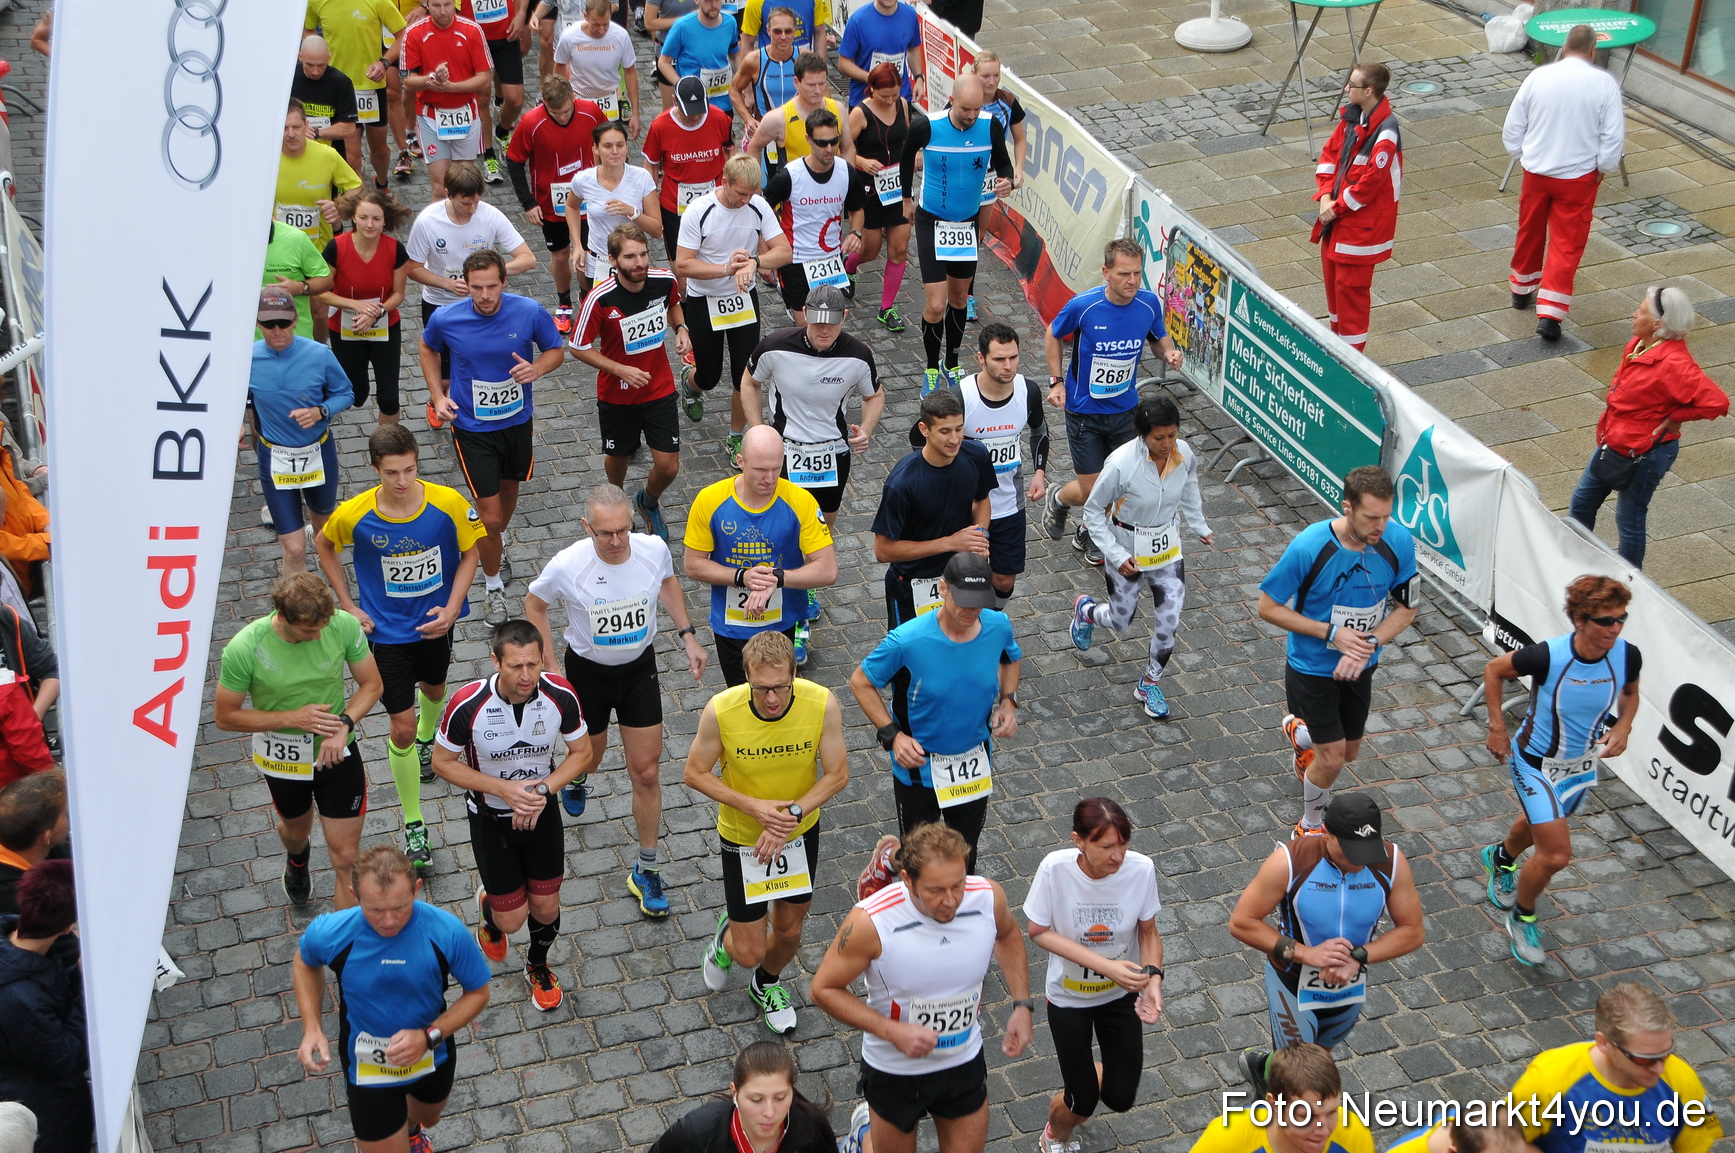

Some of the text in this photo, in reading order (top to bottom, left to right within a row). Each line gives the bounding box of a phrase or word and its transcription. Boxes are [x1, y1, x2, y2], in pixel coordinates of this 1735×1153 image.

[577, 44, 611, 52] Continental
[707, 74, 727, 88] 156
[440, 111, 471, 127] 2164
[670, 150, 714, 163] NEUMARKT
[799, 195, 843, 206] Oberbank
[285, 212, 313, 228] 603
[939, 231, 973, 245] 3399
[809, 259, 842, 279] 2314
[717, 295, 744, 314] 639
[621, 310, 659, 328] PARTL Neumarkt
[627, 315, 665, 342] 2243
[636, 336, 661, 349] Thomas
[1095, 338, 1142, 352] SYSCAD
[1253, 311, 1325, 378] Event-Leit-Systeme
[1095, 366, 1132, 384] 2681
[1231, 332, 1325, 428] Mehr Sicherheit
[478, 385, 520, 407] 2425
[1104, 386, 1119, 394] Marc
[1230, 359, 1308, 441] für Ihr Event!
[489, 404, 512, 417] Fabian
[986, 424, 1016, 432] KLEBL
[605, 439, 615, 450] 16
[787, 446, 828, 455] PARTL Neumarkt
[1227, 394, 1341, 504] Miet & Service Line: 09181 6352
[272, 448, 315, 457] PARTL Neumarkt
[287, 457, 309, 473] 17
[792, 453, 832, 471] 2459
[278, 472, 318, 484] Franz Xaver
[799, 473, 825, 482] Andreas
[132, 274, 214, 749] Audi BKK
[1151, 534, 1169, 554] 59
[404, 554, 431, 566] Neumarkt
[1148, 553, 1171, 566] Sunday
[1419, 544, 1443, 570] Service
[1444, 565, 1466, 587] GmbH
[389, 558, 437, 582] 2275
[397, 581, 433, 592] Christian
[612, 601, 640, 612] Neumarkt
[1333, 608, 1354, 617] PARTL
[597, 608, 646, 635] 2946
[1343, 614, 1377, 633] 652
[608, 634, 638, 646] Markus
[263, 739, 301, 762] 135
[490, 744, 550, 759] WOLFRUM
[736, 740, 813, 756] KLINGELE
[262, 760, 299, 774] Matthias
[944, 758, 982, 784] 142
[949, 783, 981, 798] Volkmar
[764, 853, 789, 878] 79
[765, 879, 790, 892] Klaus
[1079, 983, 1115, 992] Irmgard
[911, 996, 971, 1011] PARTL Neumarkt
[916, 1005, 974, 1034] 2525
[357, 1037, 381, 1048] PARTL
[380, 1065, 413, 1076] Günter
